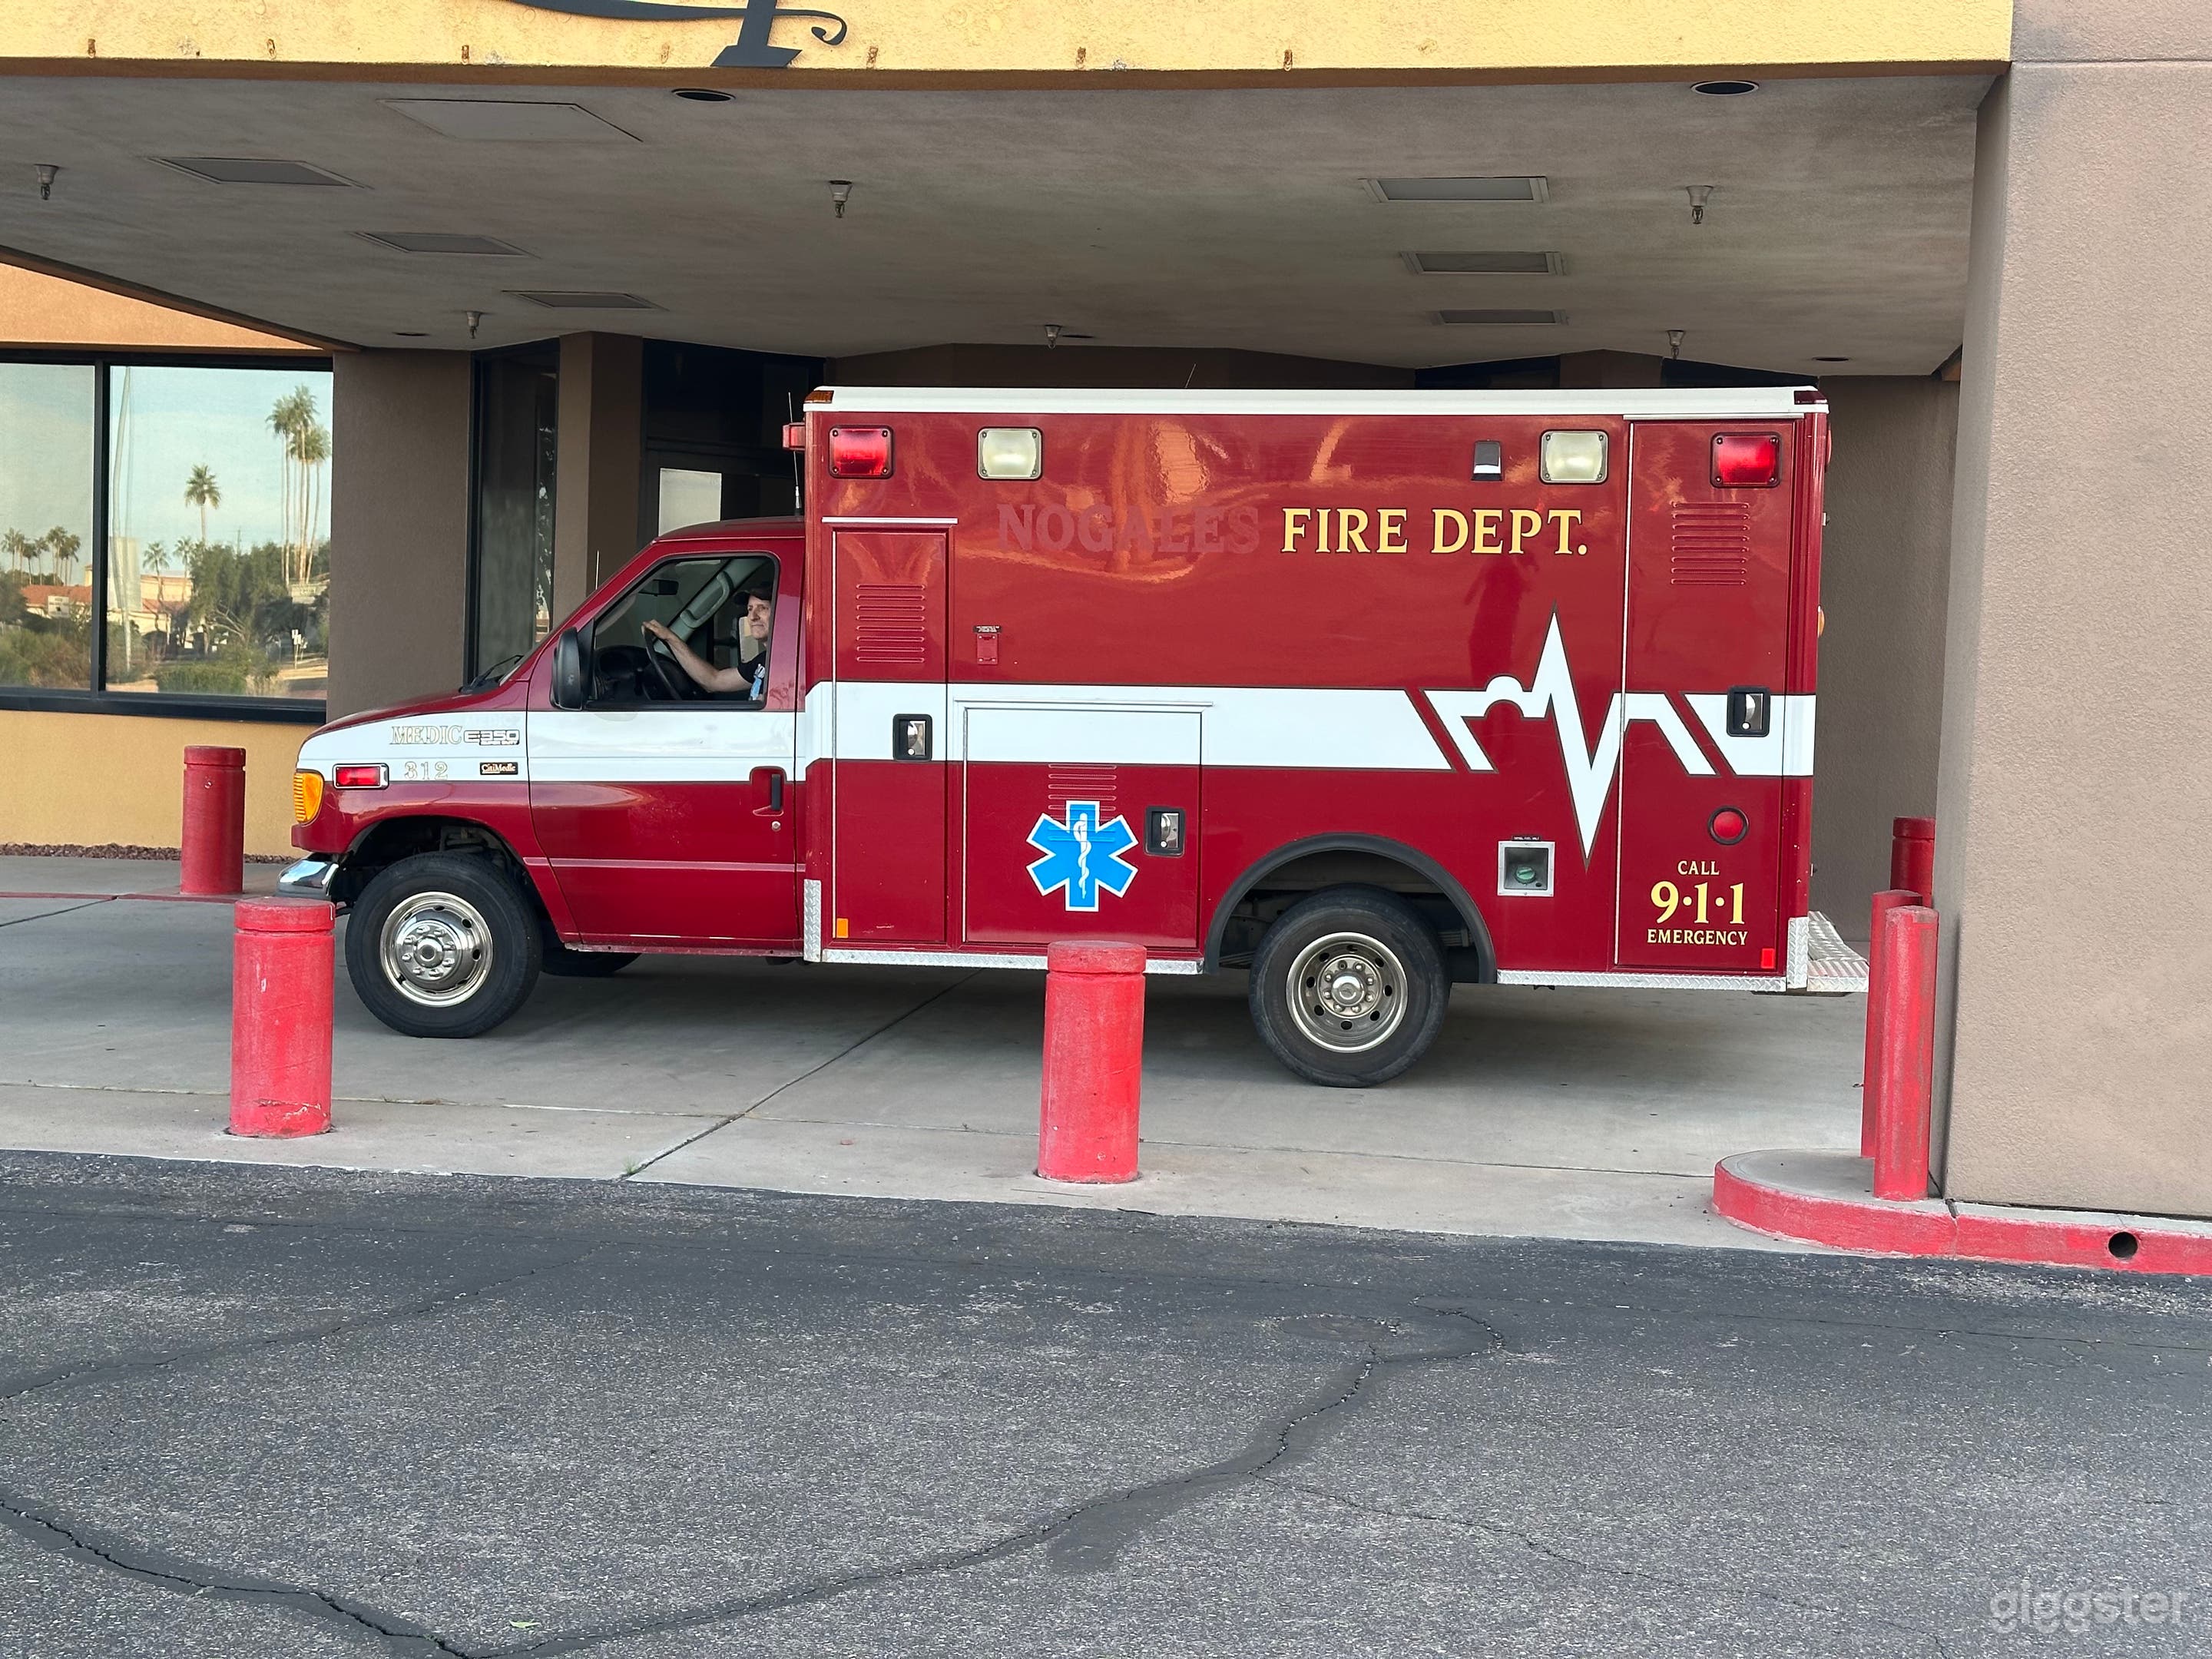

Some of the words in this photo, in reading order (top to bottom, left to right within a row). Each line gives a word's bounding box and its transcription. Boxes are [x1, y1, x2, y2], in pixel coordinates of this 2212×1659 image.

[997, 504, 1260, 553] NOGALES
[1281, 507, 1408, 554] FIRE
[1431, 508, 1588, 556] DEPT.
[389, 725, 462, 745] MEDIC
[1677, 861, 1720, 876] CALL
[1647, 929, 1748, 945] EMERGENCY
